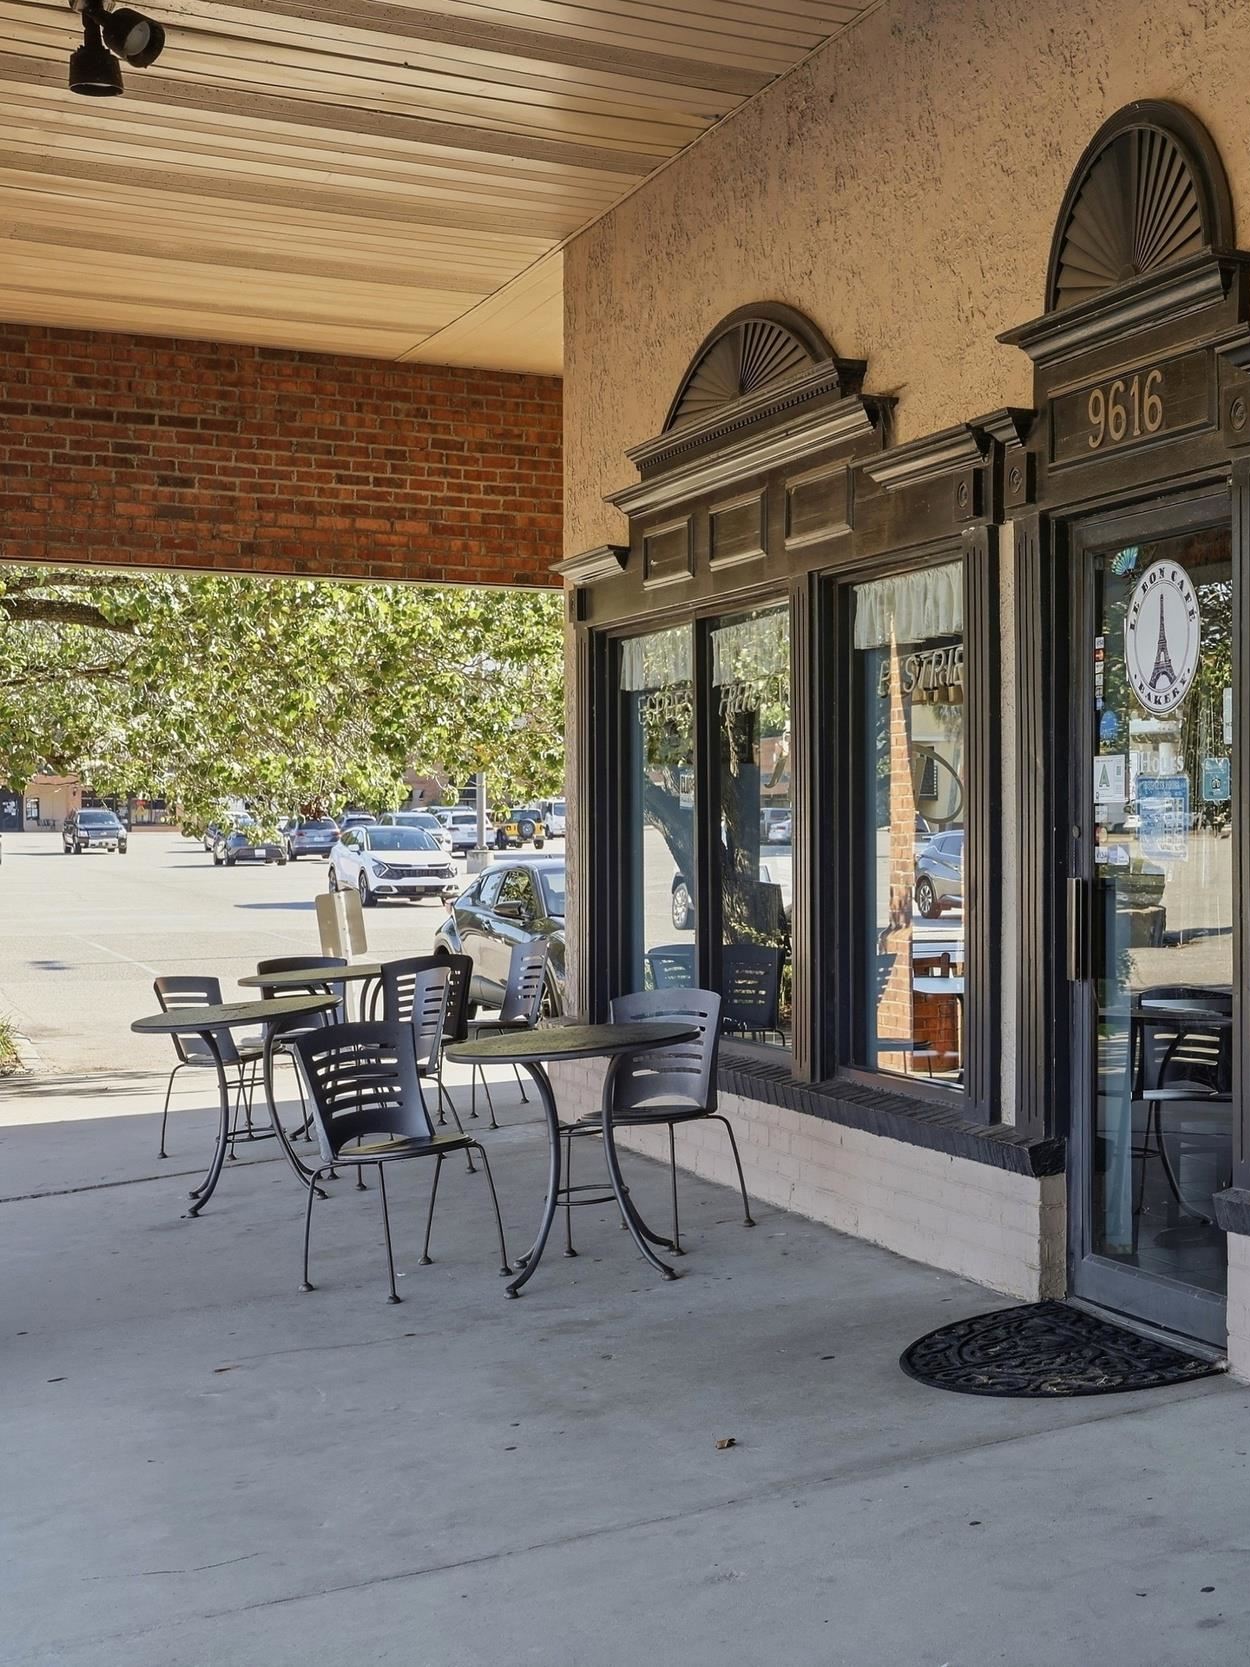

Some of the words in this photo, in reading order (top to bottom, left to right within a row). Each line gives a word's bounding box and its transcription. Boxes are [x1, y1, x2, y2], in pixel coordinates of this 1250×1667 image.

[1088, 369, 1162, 449] 9616
[1129, 600, 1141, 631] LE
[1141, 567, 1166, 595] BON
[1138, 673, 1188, 706] BAKERY
